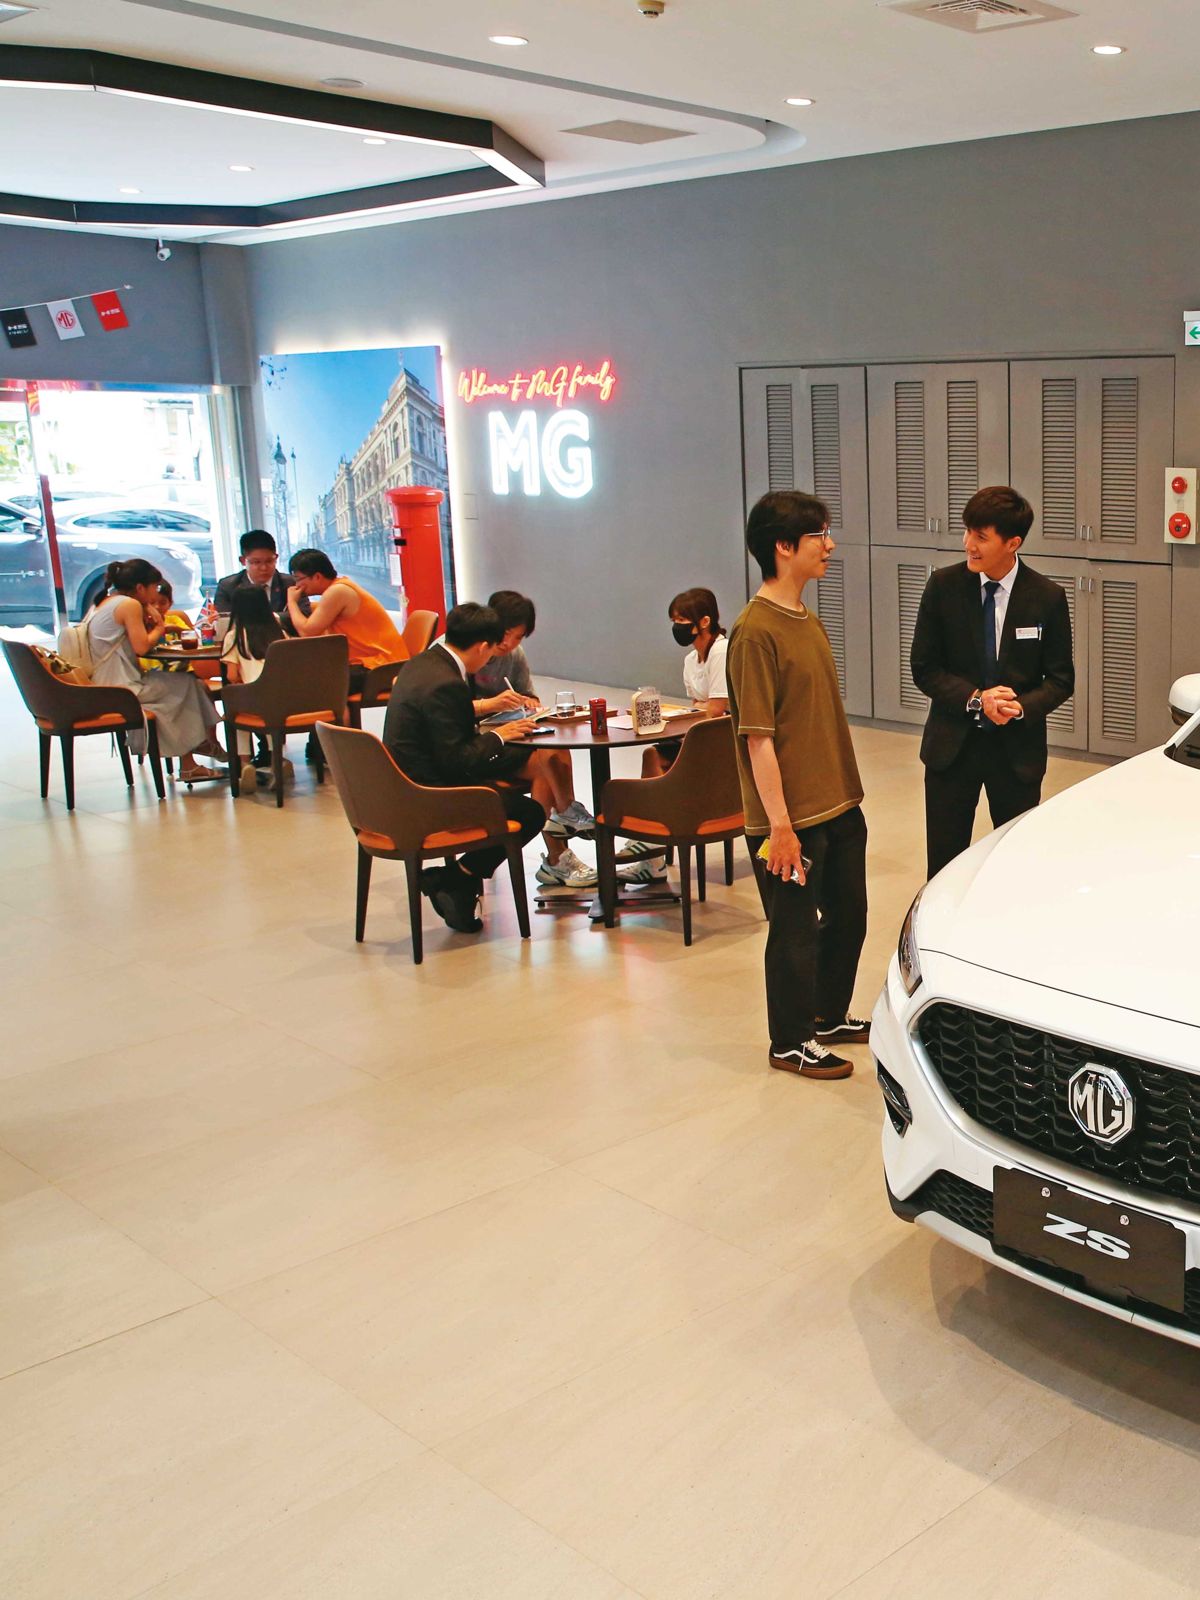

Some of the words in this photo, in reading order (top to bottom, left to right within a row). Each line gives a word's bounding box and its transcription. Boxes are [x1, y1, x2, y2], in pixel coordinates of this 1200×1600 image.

[57, 311, 75, 328] MG
[526, 365, 569, 408] MG
[488, 409, 594, 499] MG
[1072, 1071, 1123, 1135] MG
[1042, 1211, 1131, 1260] ZS
